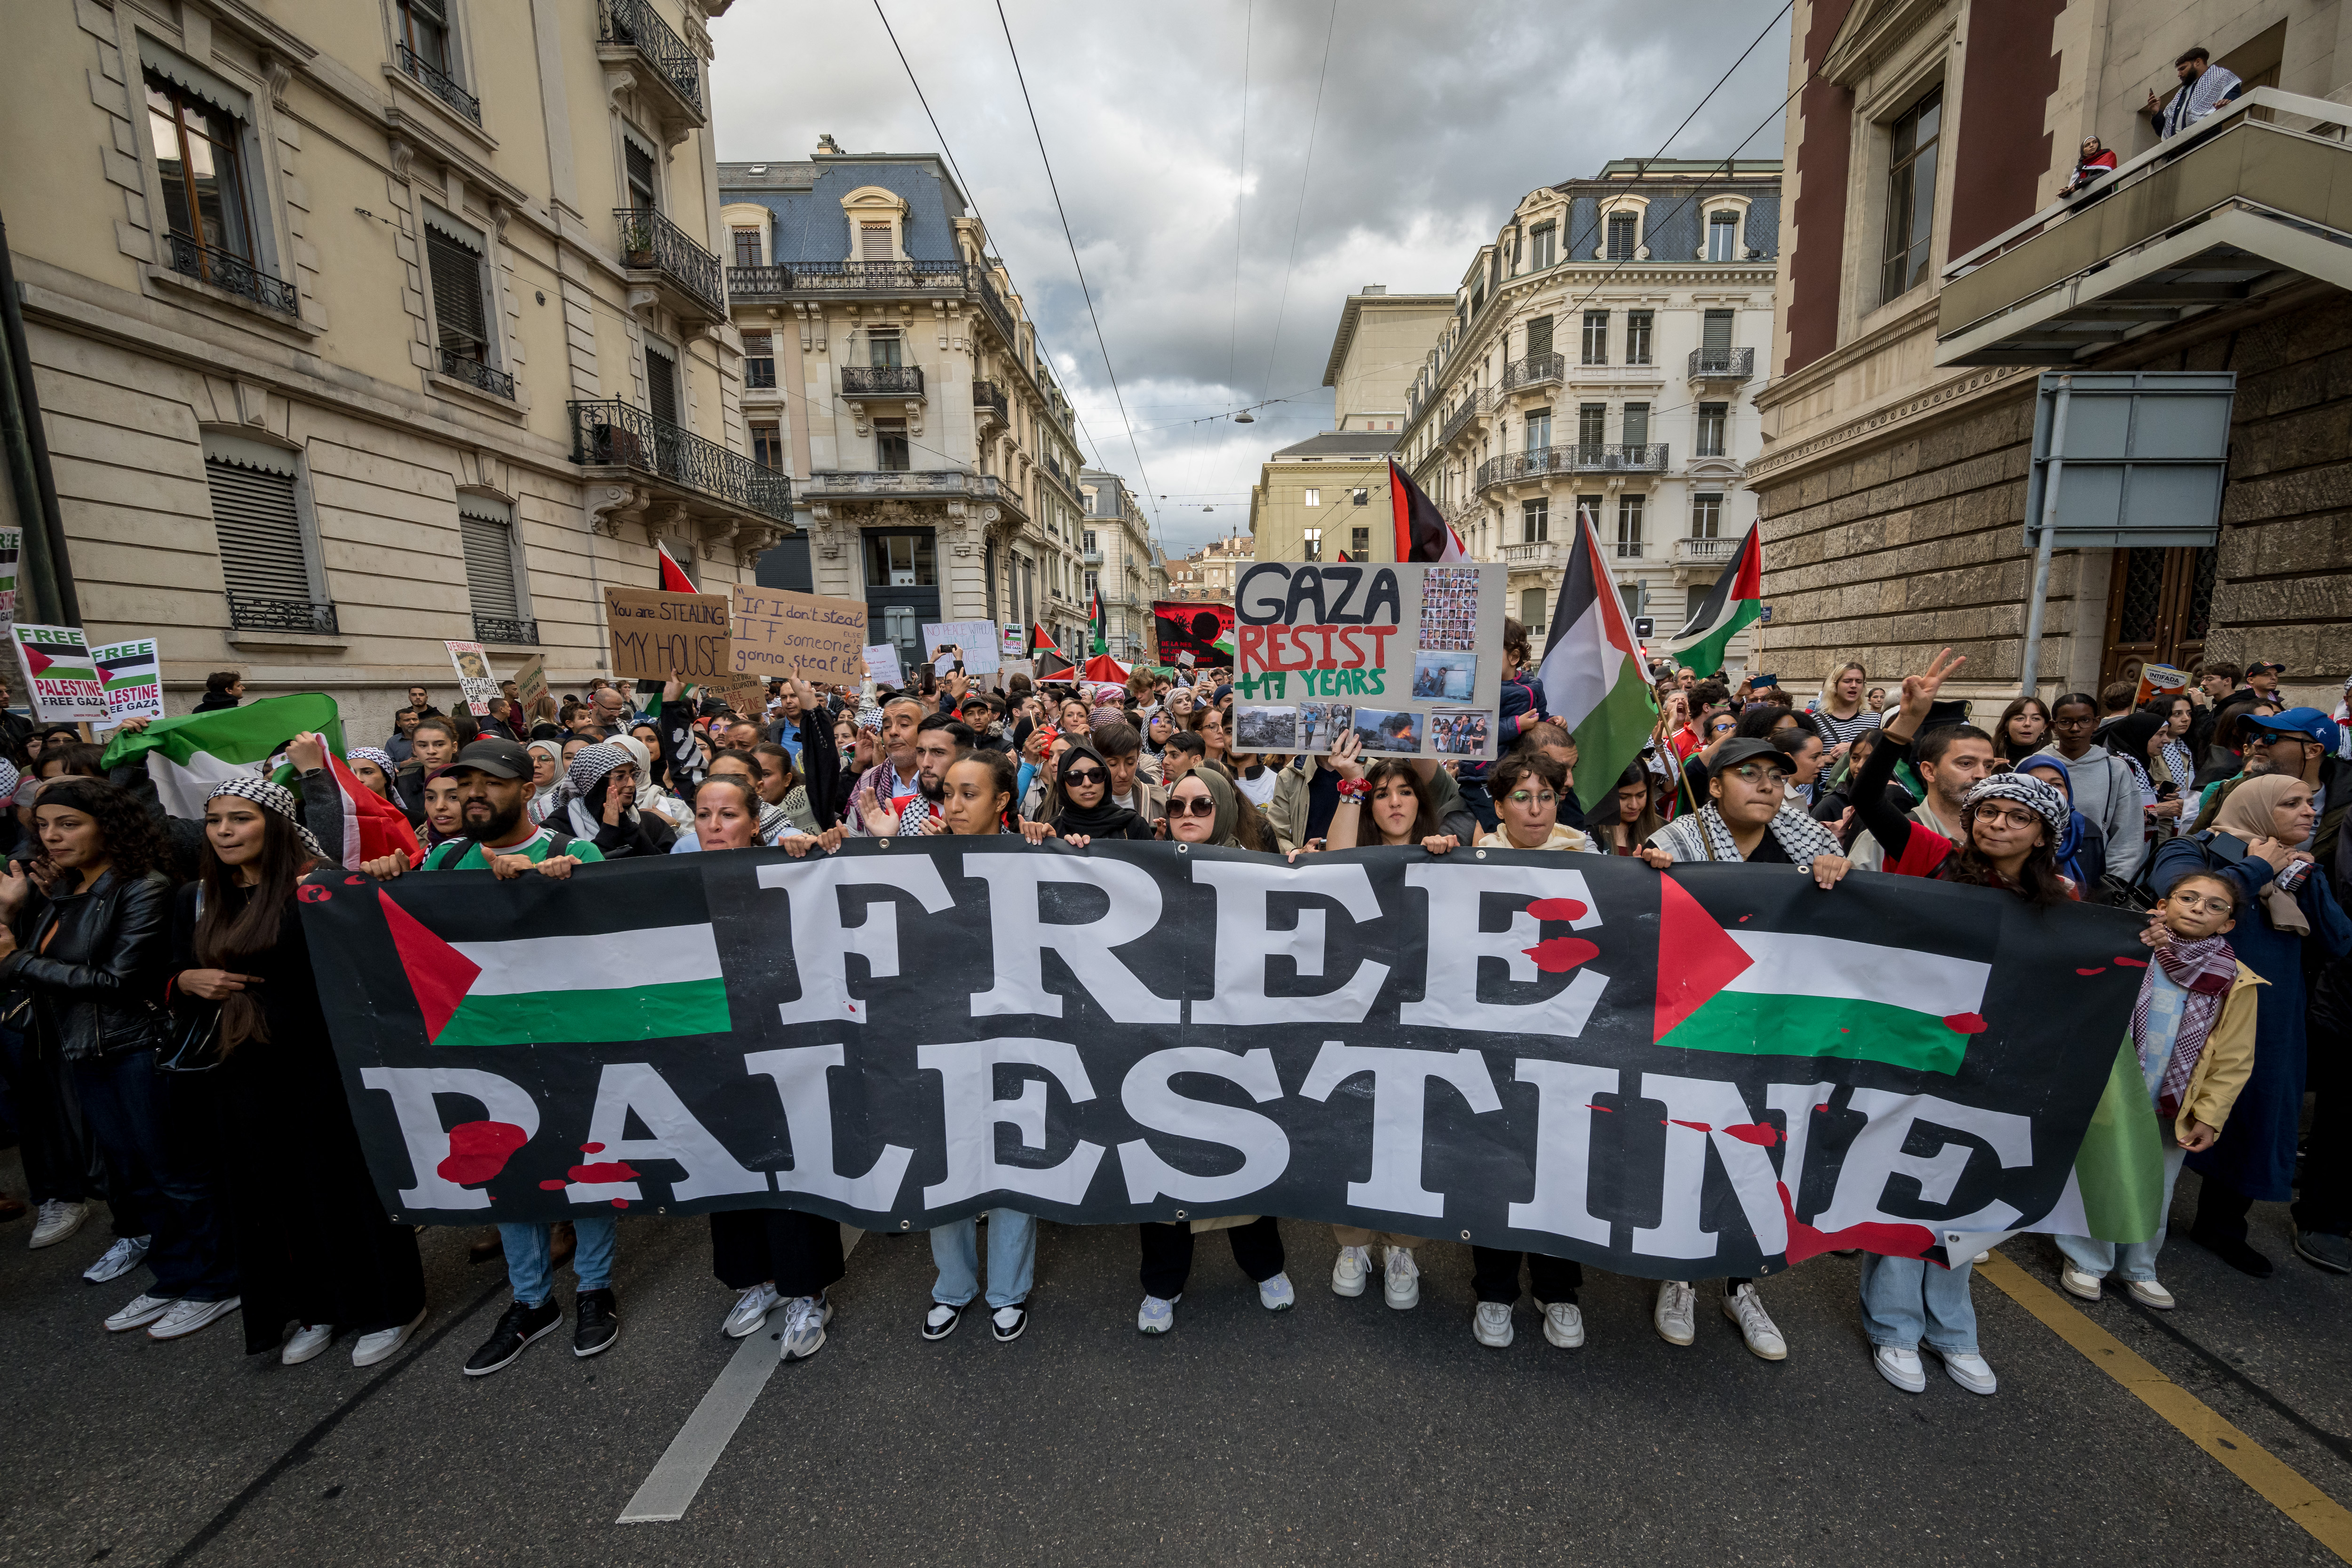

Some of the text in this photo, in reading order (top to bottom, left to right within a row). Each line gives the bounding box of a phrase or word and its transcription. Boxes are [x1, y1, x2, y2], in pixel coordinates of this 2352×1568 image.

[0, 533, 20, 549] REE
[1235, 562, 1400, 625] GAZA
[636, 608, 655, 618] are
[771, 601, 784, 617] I
[787, 605, 818, 621] don't
[821, 610, 864, 628] steal
[16, 628, 85, 645] FREE
[926, 623, 994, 636] NO PEACE WITHOUT
[91, 642, 153, 662] FREE
[447, 642, 485, 654] JERUSALEM
[615, 630, 649, 672] MY
[784, 635, 861, 654] someone's
[1239, 624, 1398, 673] RESIST
[736, 650, 784, 671] gonna
[789, 654, 838, 672] steal
[972, 660, 1000, 674] RETURN
[461, 678, 496, 687] CAPITALE
[519, 665, 542, 692] PALESTINE
[1234, 668, 1386, 700] +17 YEARS
[2149, 673, 2179, 683] INTIFADA
[35, 680, 104, 697] PALESTINE
[109, 684, 159, 705] LESTINE
[465, 687, 500, 695] ETERNELLE
[526, 681, 540, 698] VIVRA
[710, 680, 757, 694] FRENCH OCCUPATION
[41, 697, 106, 706] FREE GAZA
[724, 691, 744, 701] FREE
[730, 696, 762, 711] ESTINE
[110, 699, 159, 713] EE GAZA
[756, 852, 1610, 1037] FREE
[360, 1037, 2033, 1259] PALESTINE
